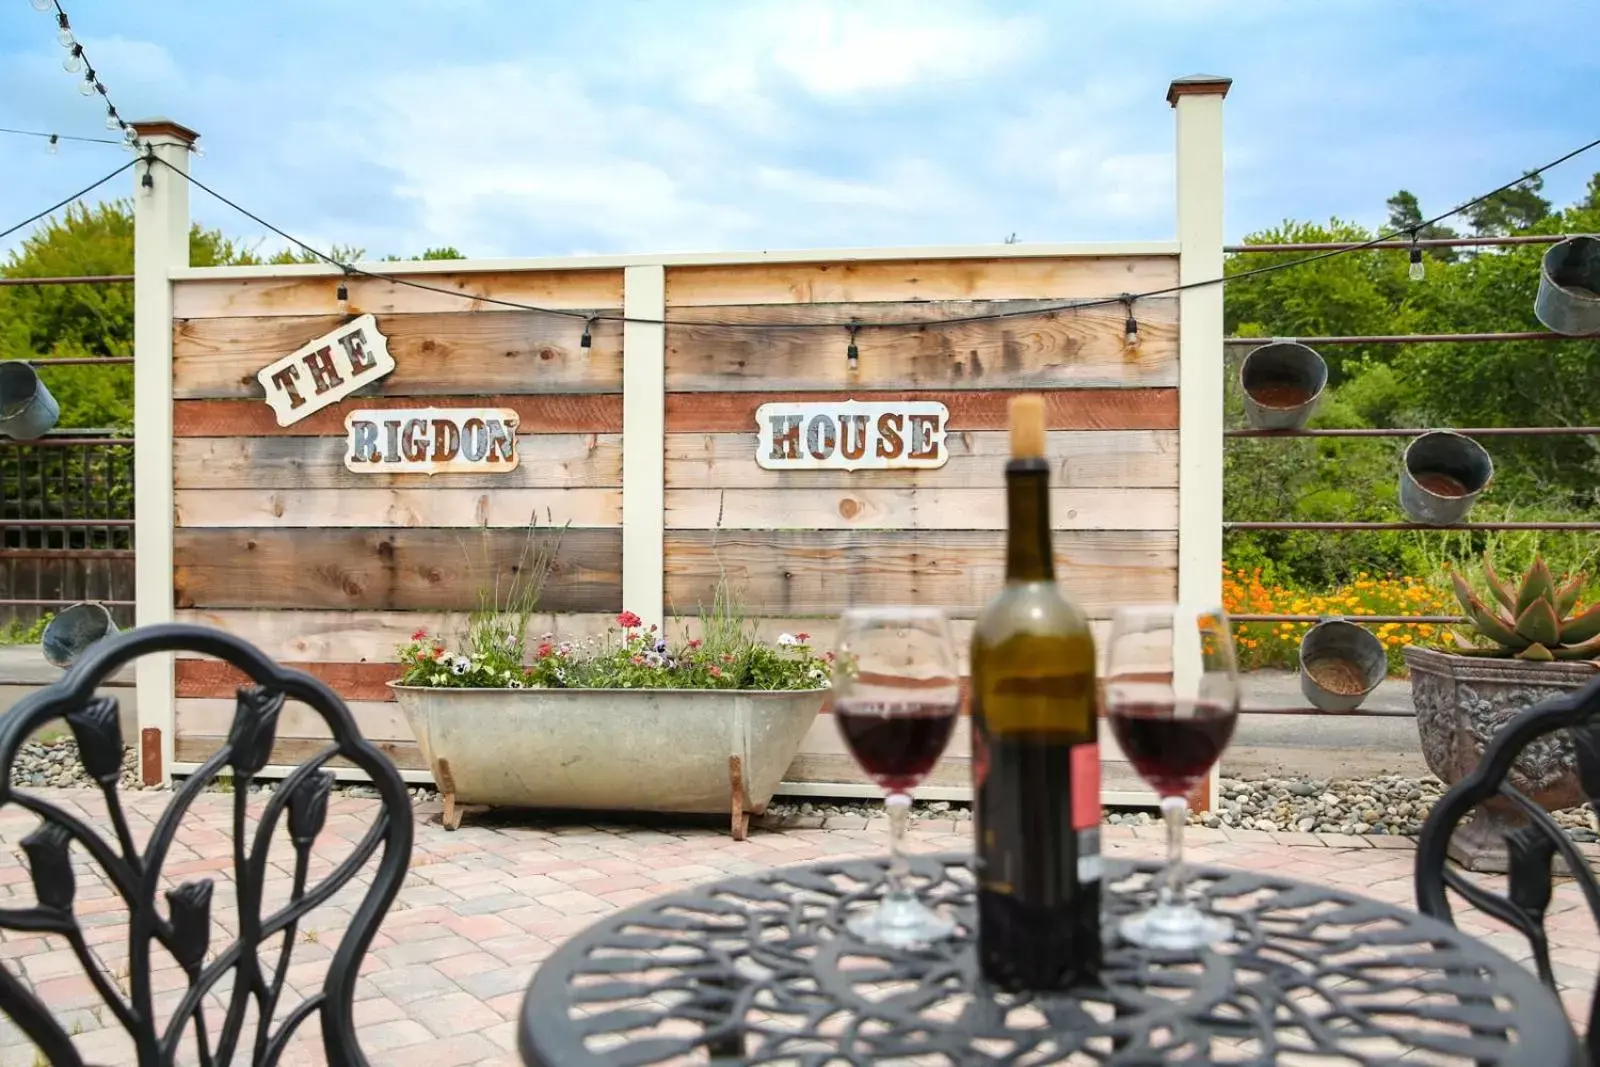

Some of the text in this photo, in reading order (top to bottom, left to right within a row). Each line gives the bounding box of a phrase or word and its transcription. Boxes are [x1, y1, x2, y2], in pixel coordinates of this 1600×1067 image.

[271, 328, 377, 409] THE
[351, 418, 515, 462] RIGDON
[769, 413, 939, 460] HOUSE
